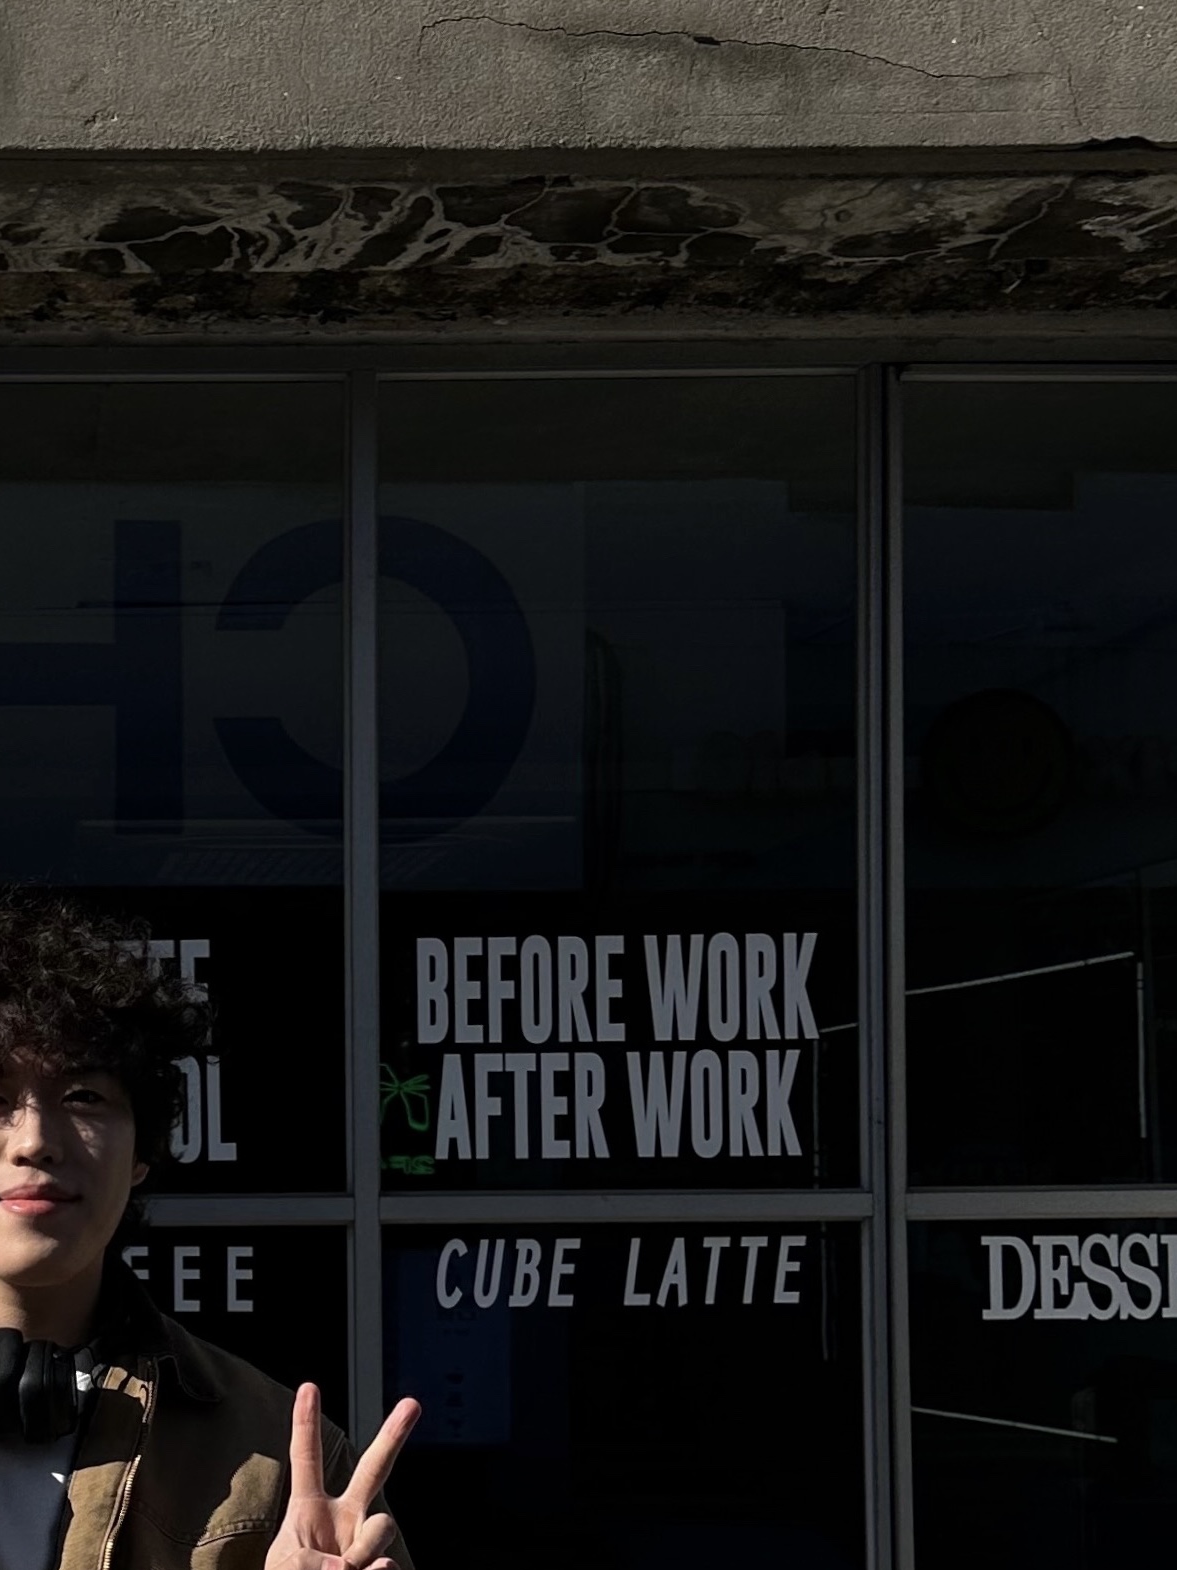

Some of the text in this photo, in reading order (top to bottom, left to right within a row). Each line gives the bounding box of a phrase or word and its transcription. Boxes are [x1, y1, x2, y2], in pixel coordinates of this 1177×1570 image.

[415, 932, 820, 1045] BEFORE WORK
[434, 1049, 804, 1161] AFTER WORK
[435, 1235, 808, 1310] CUBE LATTE
